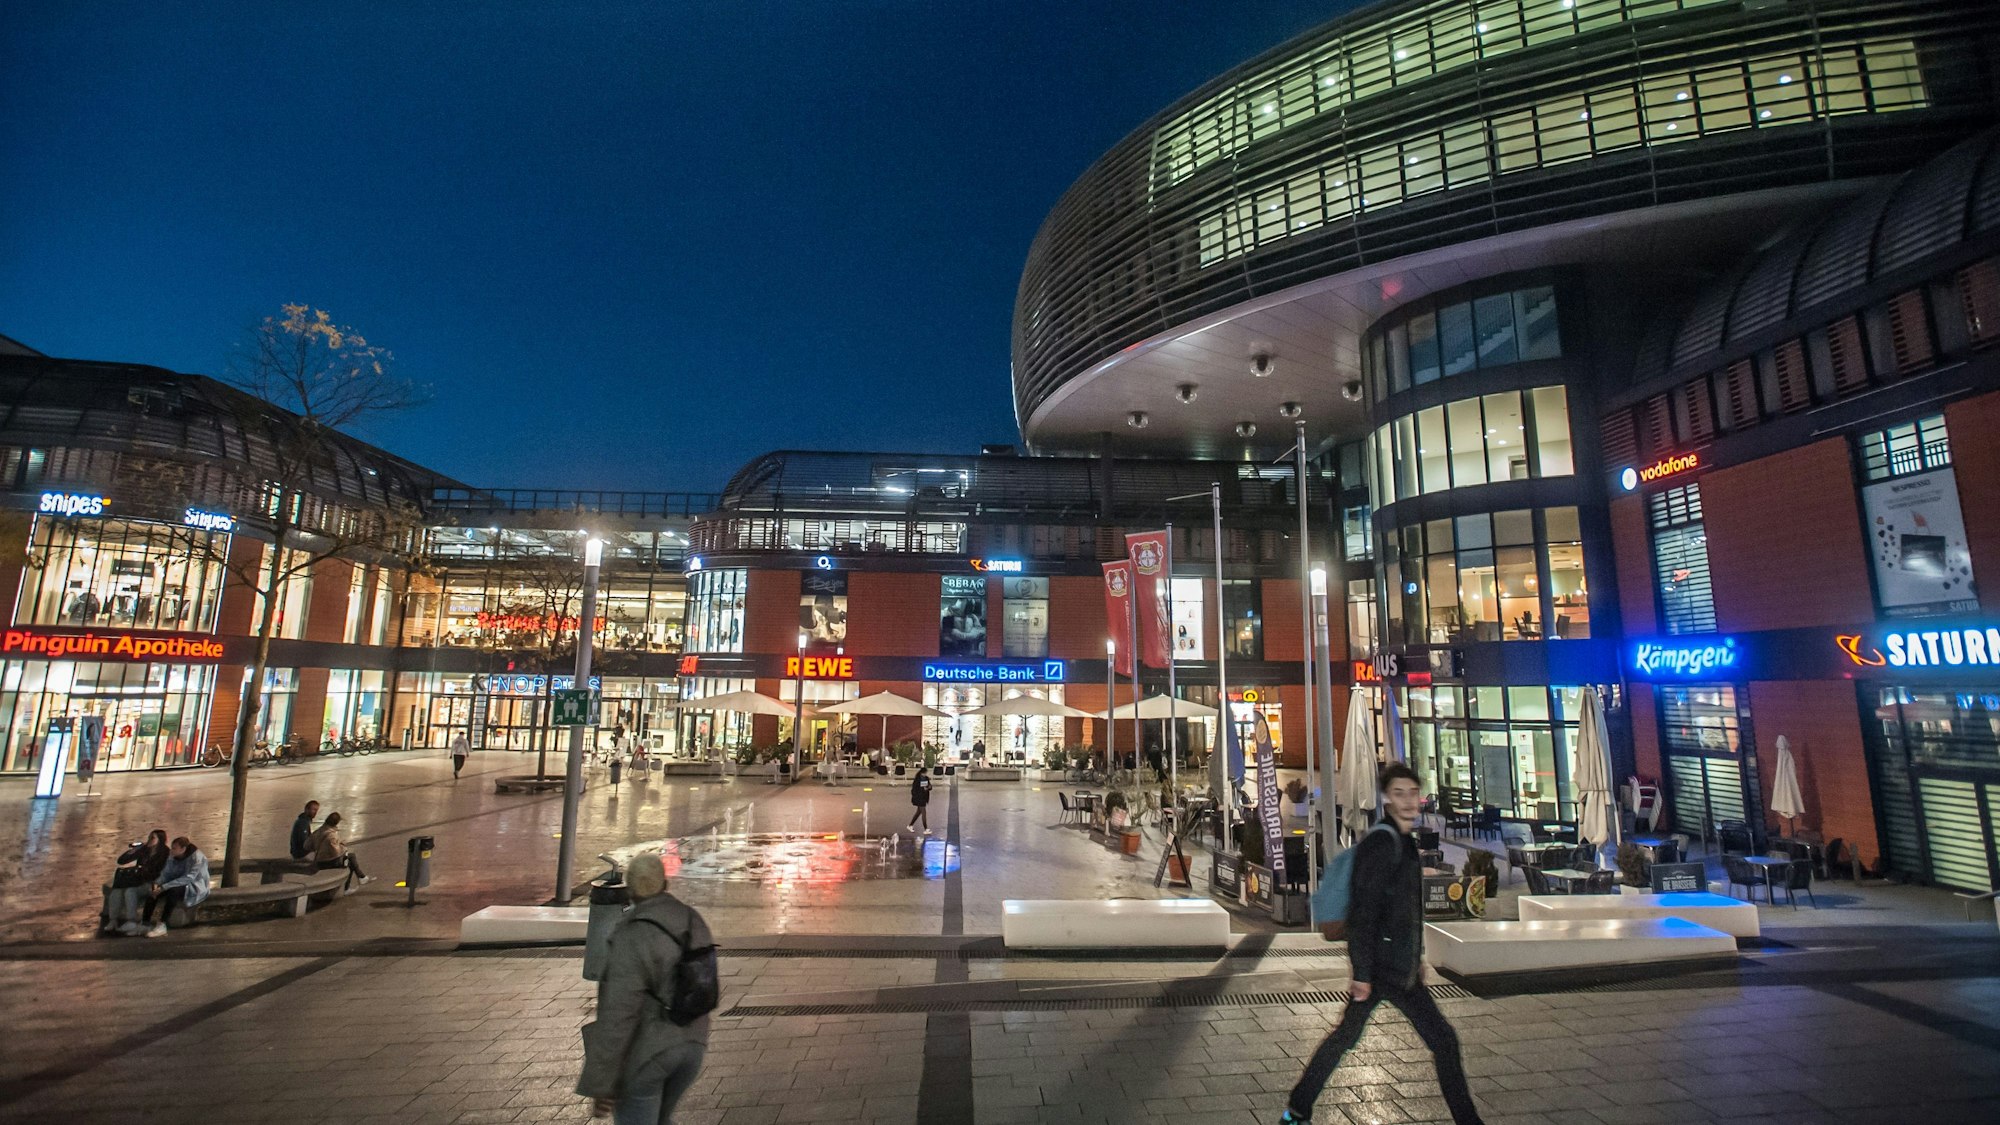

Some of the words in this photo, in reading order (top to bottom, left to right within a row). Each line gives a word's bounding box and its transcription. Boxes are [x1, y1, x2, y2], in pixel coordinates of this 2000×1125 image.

[1640, 454, 1698, 481] vodafone
[40, 492, 103, 516] snipes
[987, 560, 1022, 572] SATURN
[4, 632, 110, 656] Pinguin
[113, 635, 224, 658] Apotheke
[787, 656, 853, 678] REWE
[925, 665, 993, 680] Deutsche
[998, 666, 1035, 680] Bank
